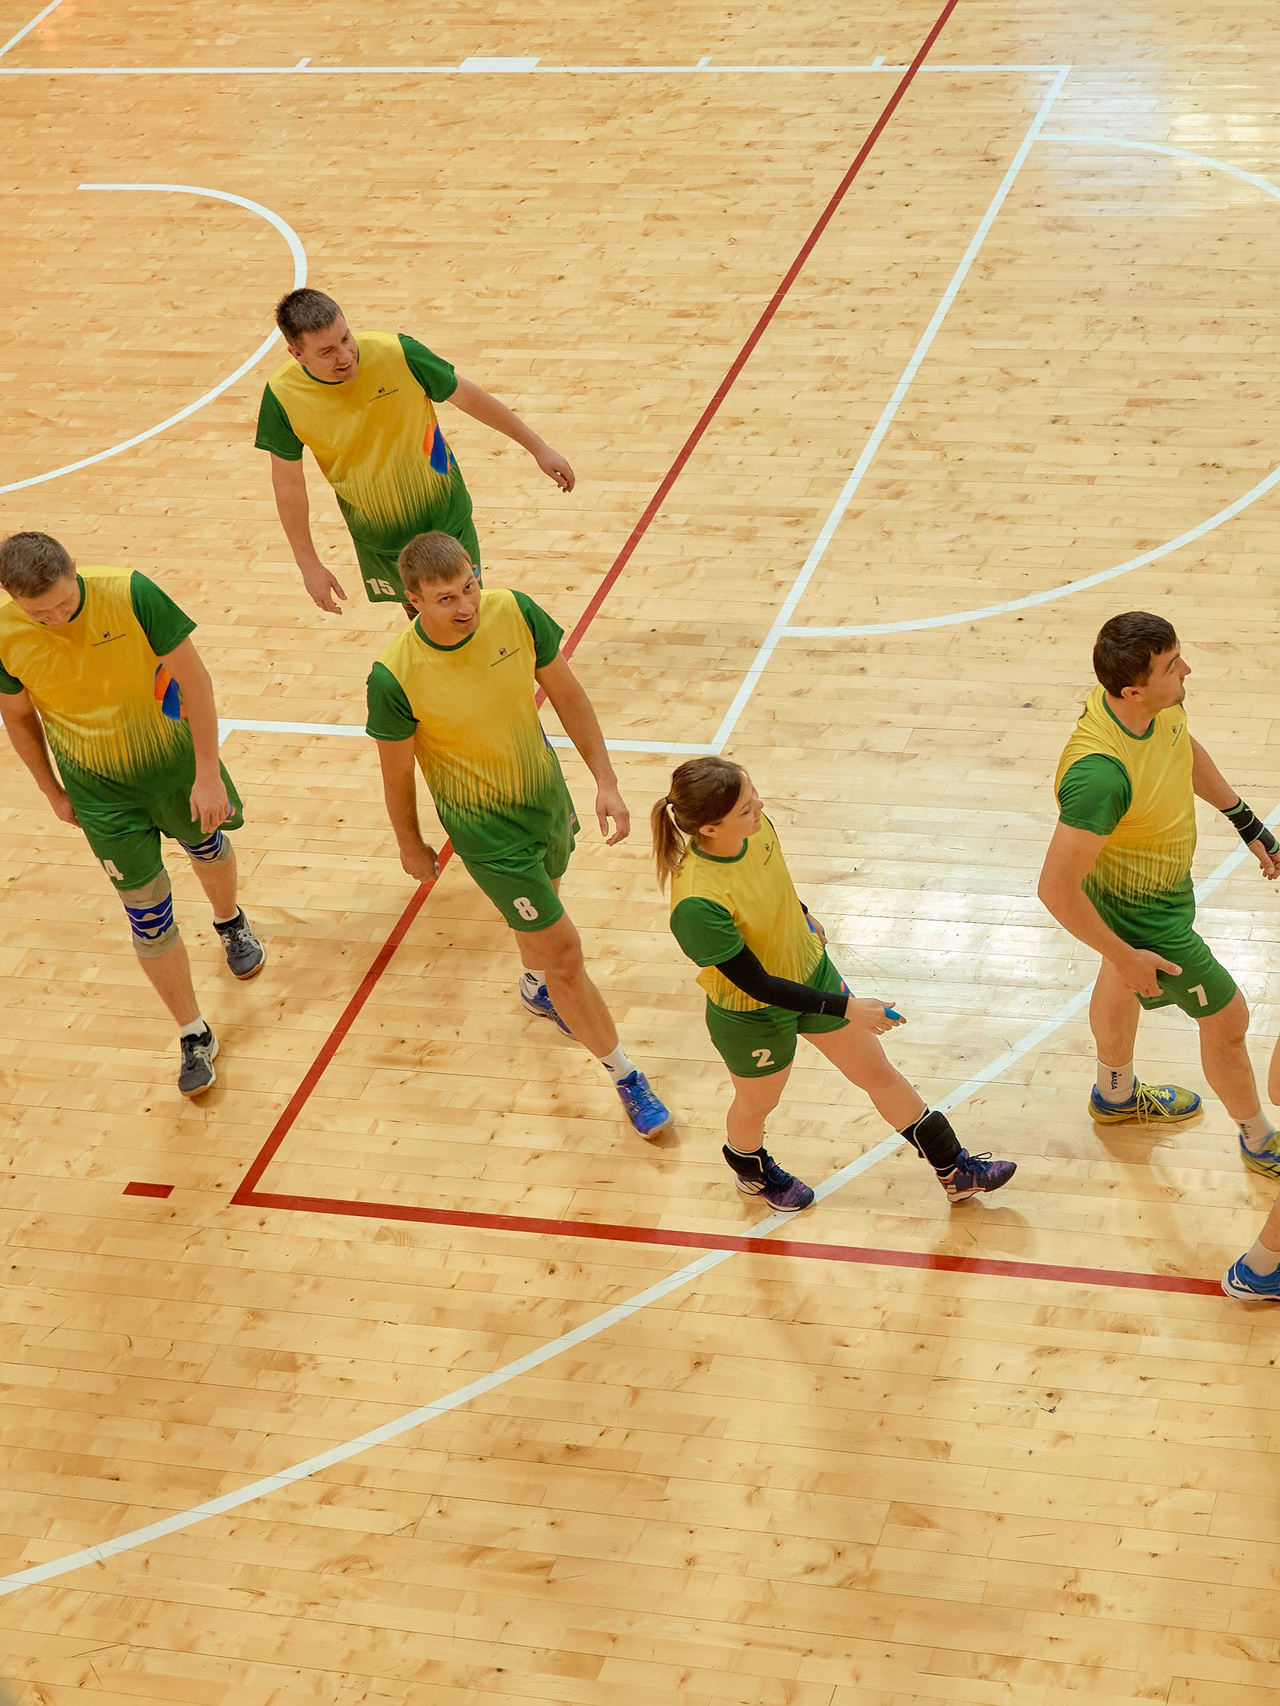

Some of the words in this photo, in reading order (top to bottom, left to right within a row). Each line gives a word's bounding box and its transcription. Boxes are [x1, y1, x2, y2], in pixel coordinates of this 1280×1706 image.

[366, 577, 396, 596] 15
[96, 856, 125, 881] 4
[512, 896, 539, 921] 8
[1187, 983, 1209, 1007] 7
[751, 1048, 775, 1068] 2
